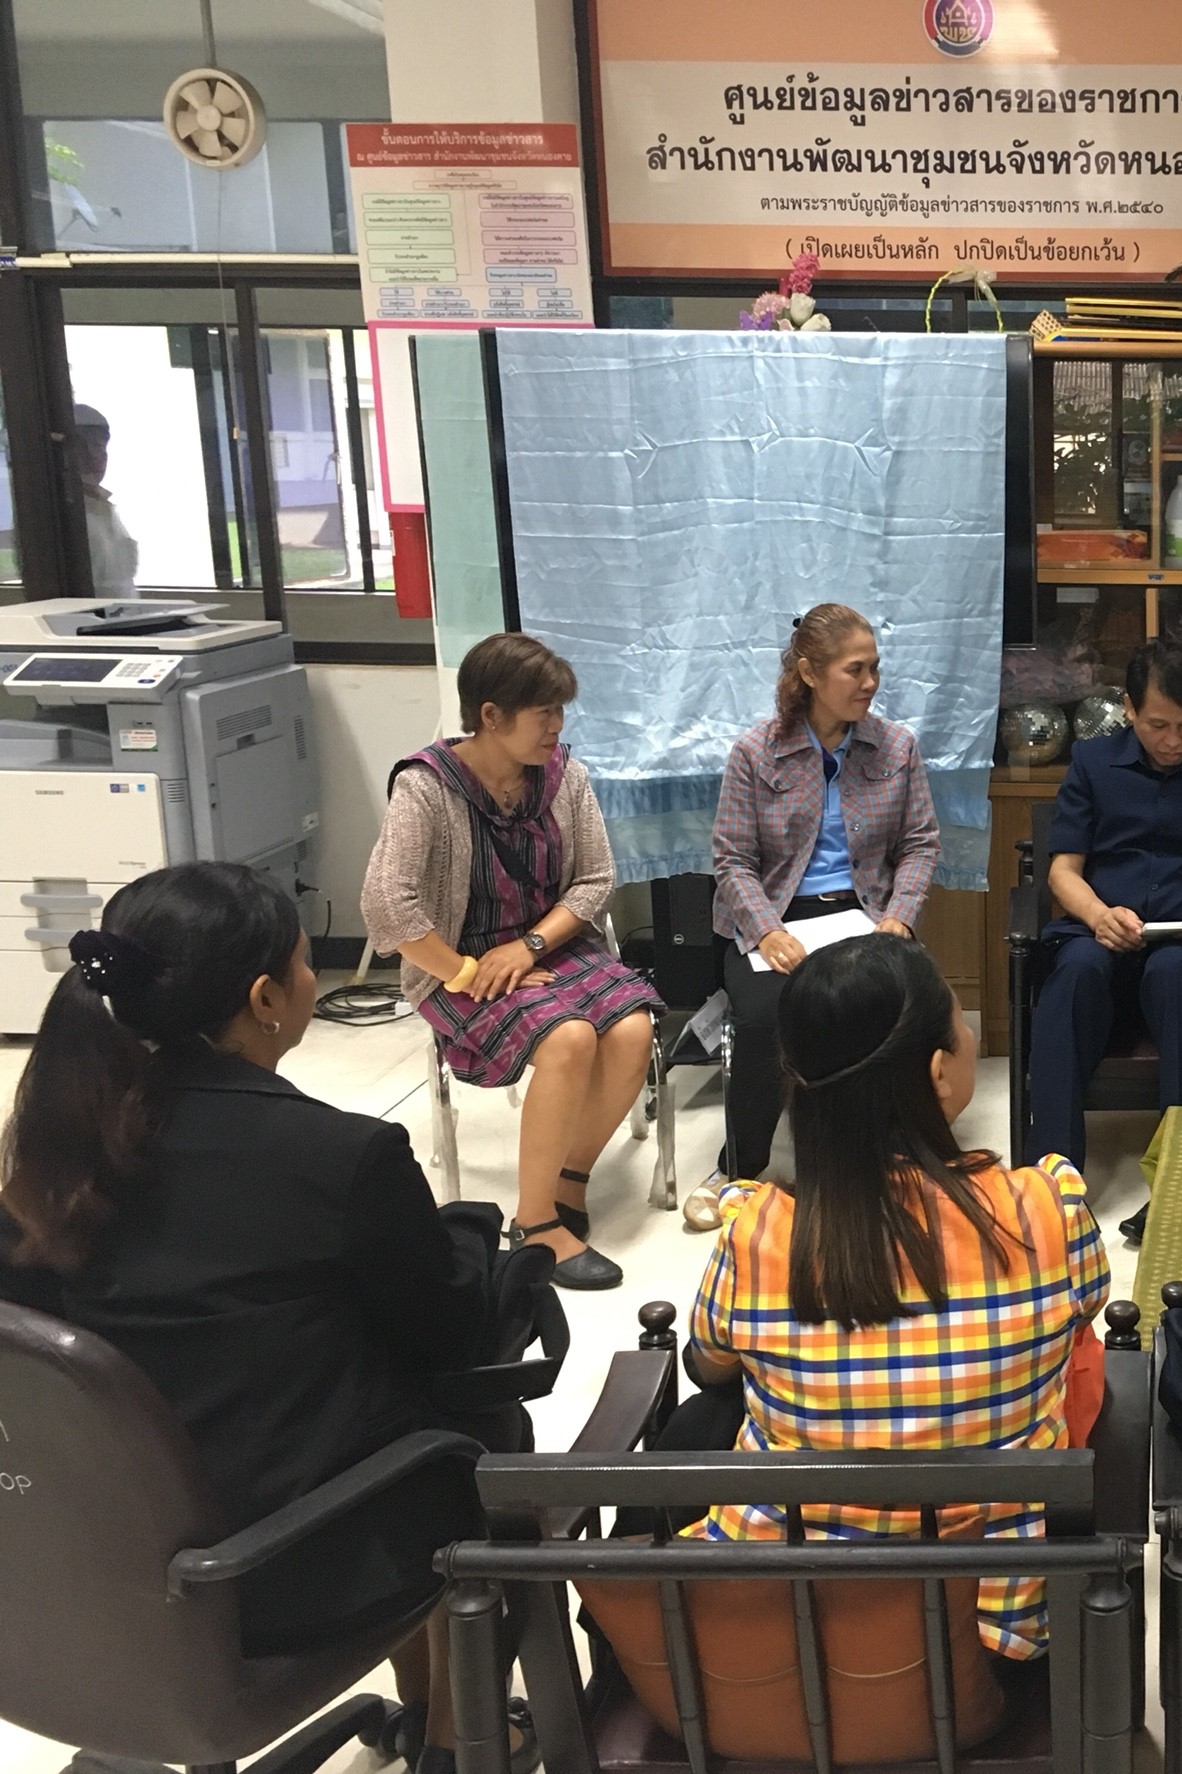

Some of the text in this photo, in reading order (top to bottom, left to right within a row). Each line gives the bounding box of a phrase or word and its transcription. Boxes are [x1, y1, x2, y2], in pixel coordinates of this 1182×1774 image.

[381, 127, 543, 149] ขั้นตอนการให้บริการข้อมูลข่าวสาร
[760, 193, 1164, 219] ตามพระราชบัญญัติข้อมูลข่าวสารของราชการ พ.ศ.๒๕๔๐
[800, 234, 939, 260] เปิดเผยเป็นหลัก
[954, 236, 1126, 262] ปกปิดเป็นข้อยกเว้น
